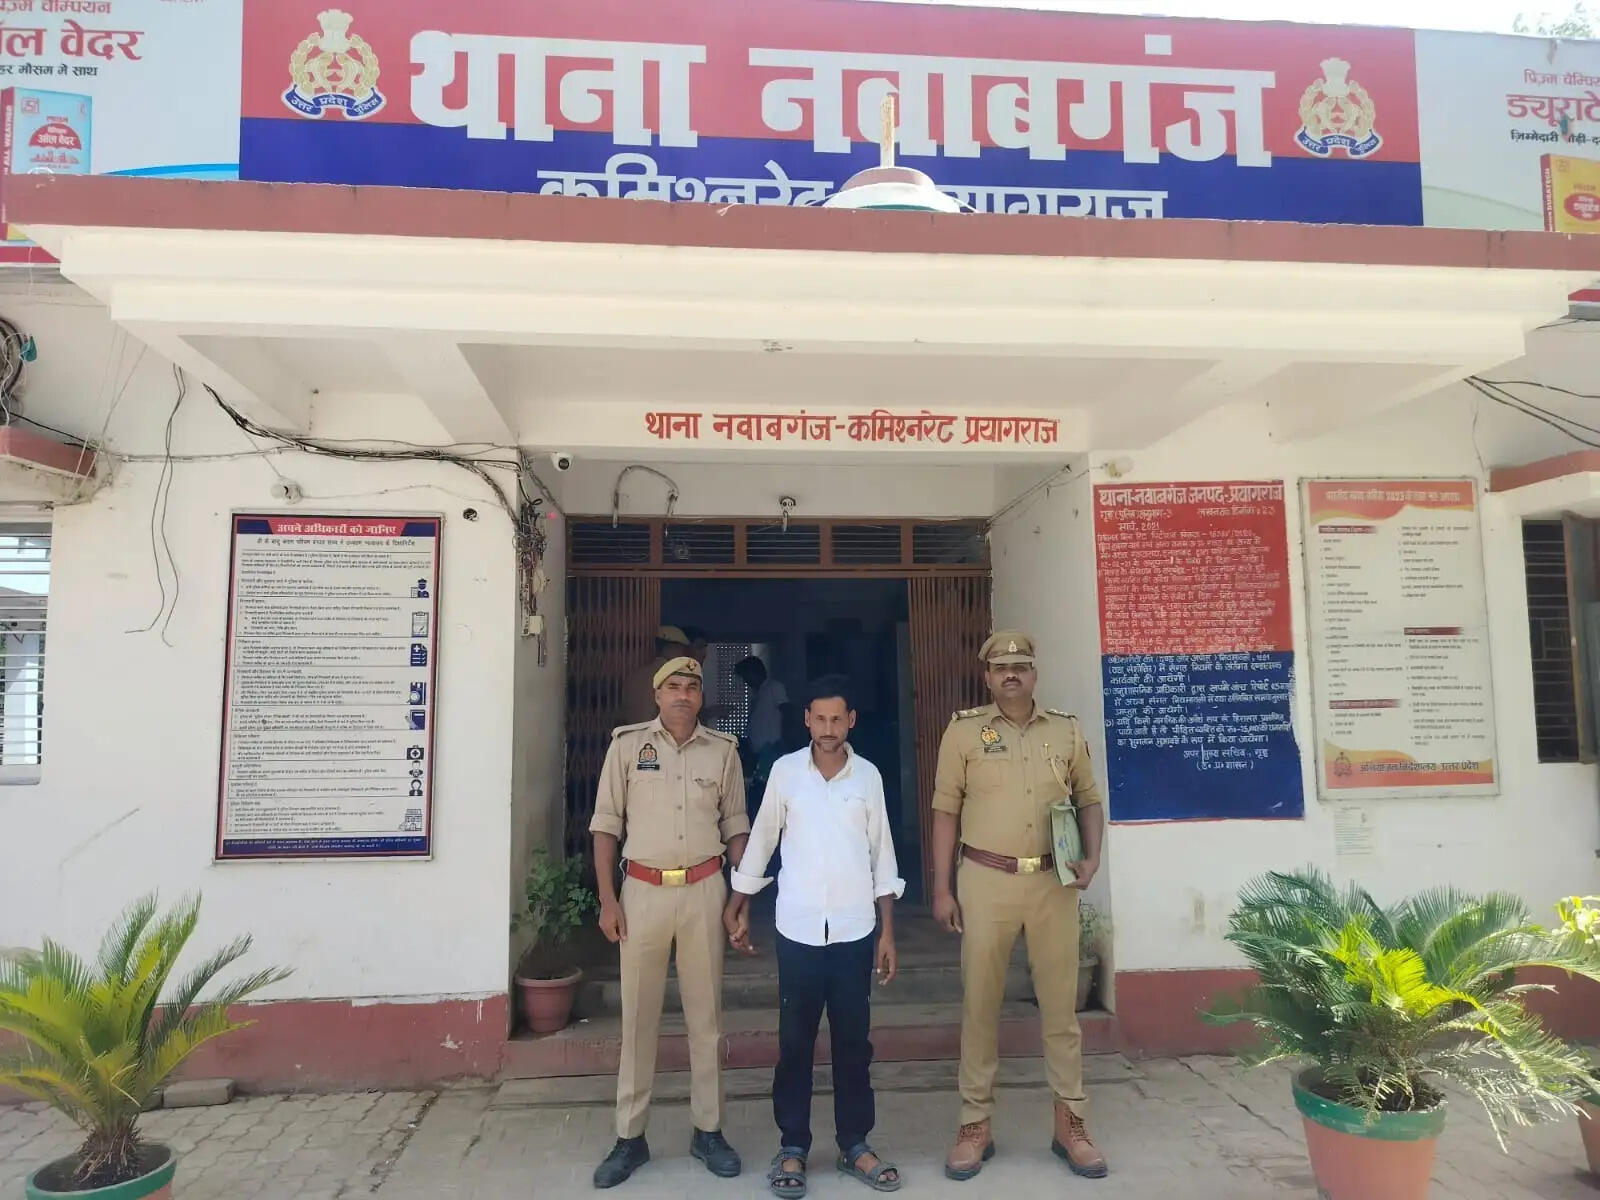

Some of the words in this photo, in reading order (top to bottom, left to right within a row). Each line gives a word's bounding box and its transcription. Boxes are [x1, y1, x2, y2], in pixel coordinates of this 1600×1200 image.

[60, 19, 145, 61] वेदर
[18, 62, 53, 76] मौसम
[72, 66, 98, 77] साथ
[292, 96, 314, 112] उत्तर
[319, 95, 348, 105] प्रदेश
[354, 98, 379, 115] पुलिस
[410, 30, 706, 148] थाना
[749, 34, 1276, 168] नवाबगंज
[1327, 135, 1350, 146] प्रदेश
[645, 412, 703, 441] थाना
[960, 415, 1061, 445] प्रयागराज
[277, 523, 302, 534] अपने
[350, 524, 363, 534] को
[365, 524, 397, 535] जानिए
[1461, 759, 1480, 771] प्रदेश
